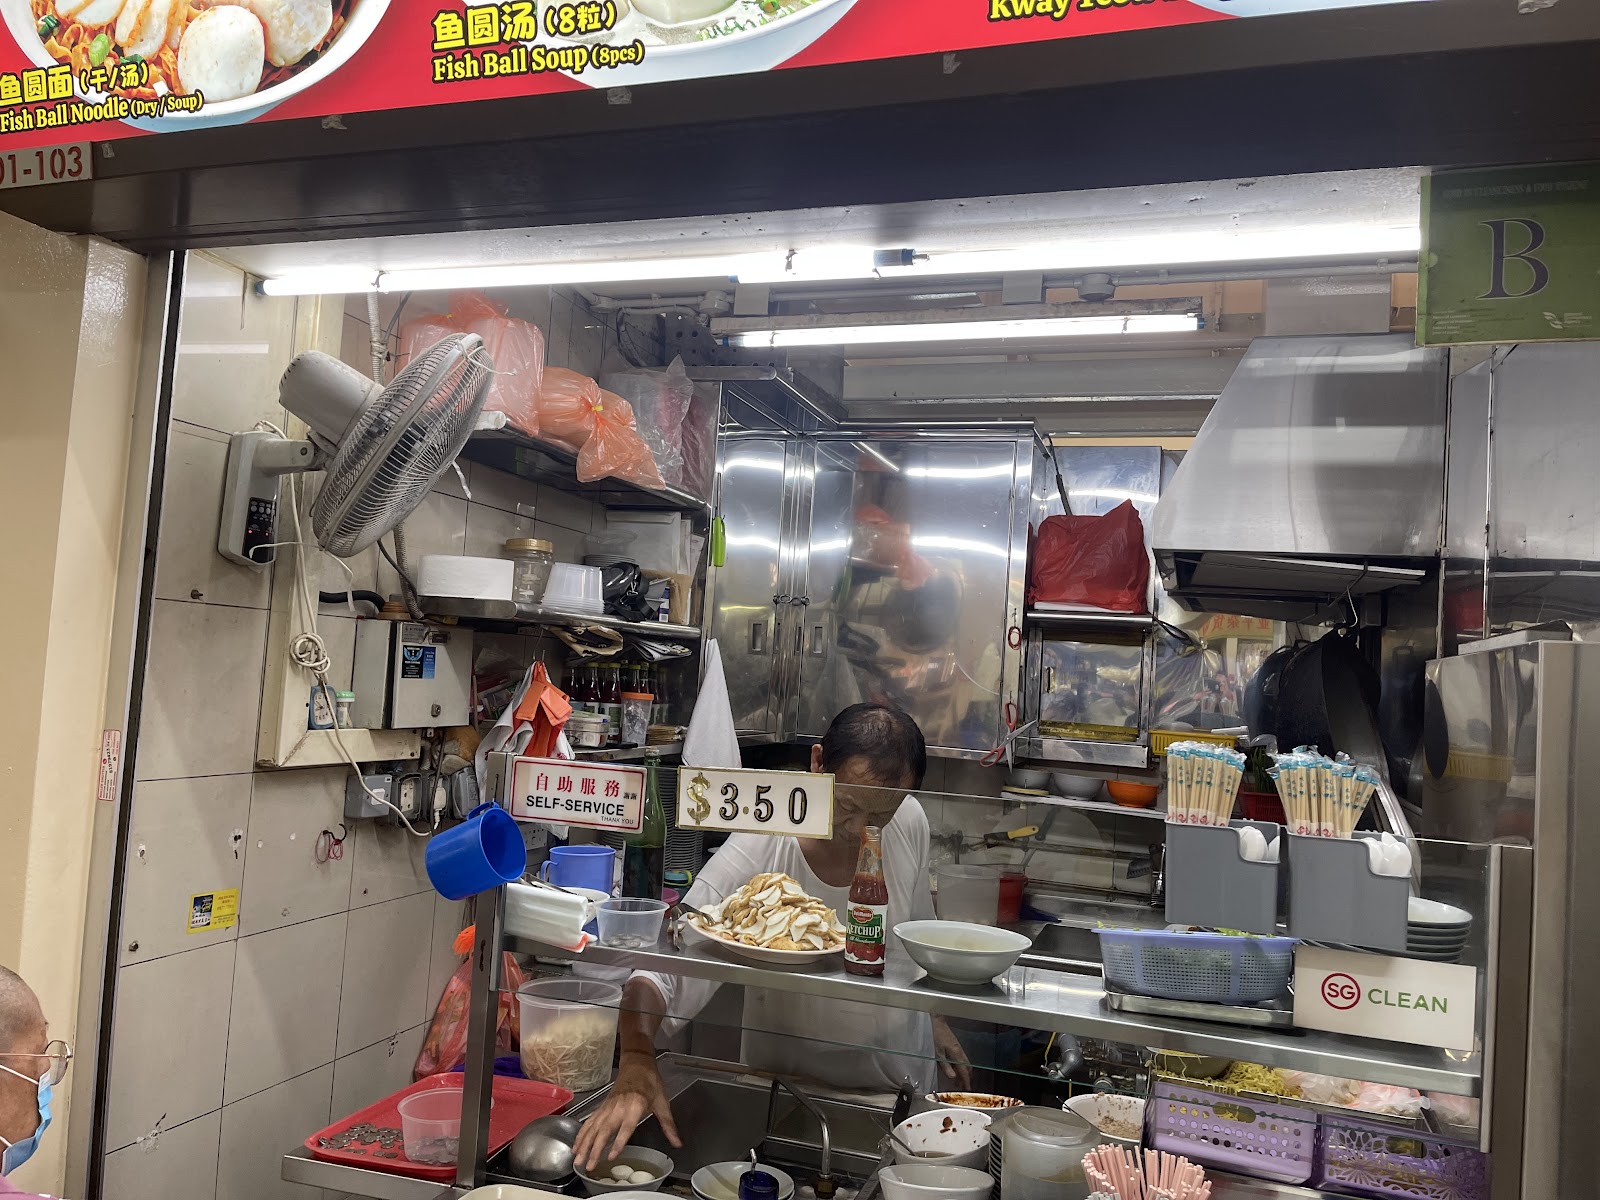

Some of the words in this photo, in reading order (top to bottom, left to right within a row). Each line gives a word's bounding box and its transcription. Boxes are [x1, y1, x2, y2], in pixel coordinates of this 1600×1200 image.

[433, 2, 537, 49] 鱼圆汤
[433, 57, 480, 81] Fish
[483, 48, 528, 75] Ball
[531, 47, 588, 73] Soup
[592, 42, 644, 67] (8pcs)
[0, 64, 74, 107] 鱼圆面
[0, 109, 33, 132] Fish
[36, 103, 70, 128] Ball
[70, 96, 129, 124] Noodle
[131, 101, 159, 118] (Dry
[167, 93, 204, 111] Soup)
[1477, 218, 1549, 300] B
[535, 772, 620, 798] 自助服務
[526, 795, 625, 817] SELF-SERVICE
[846, 922, 881, 938] KETCHUP
[1326, 982, 1356, 1000] SG
[1367, 988, 1448, 1013] CLEAN
